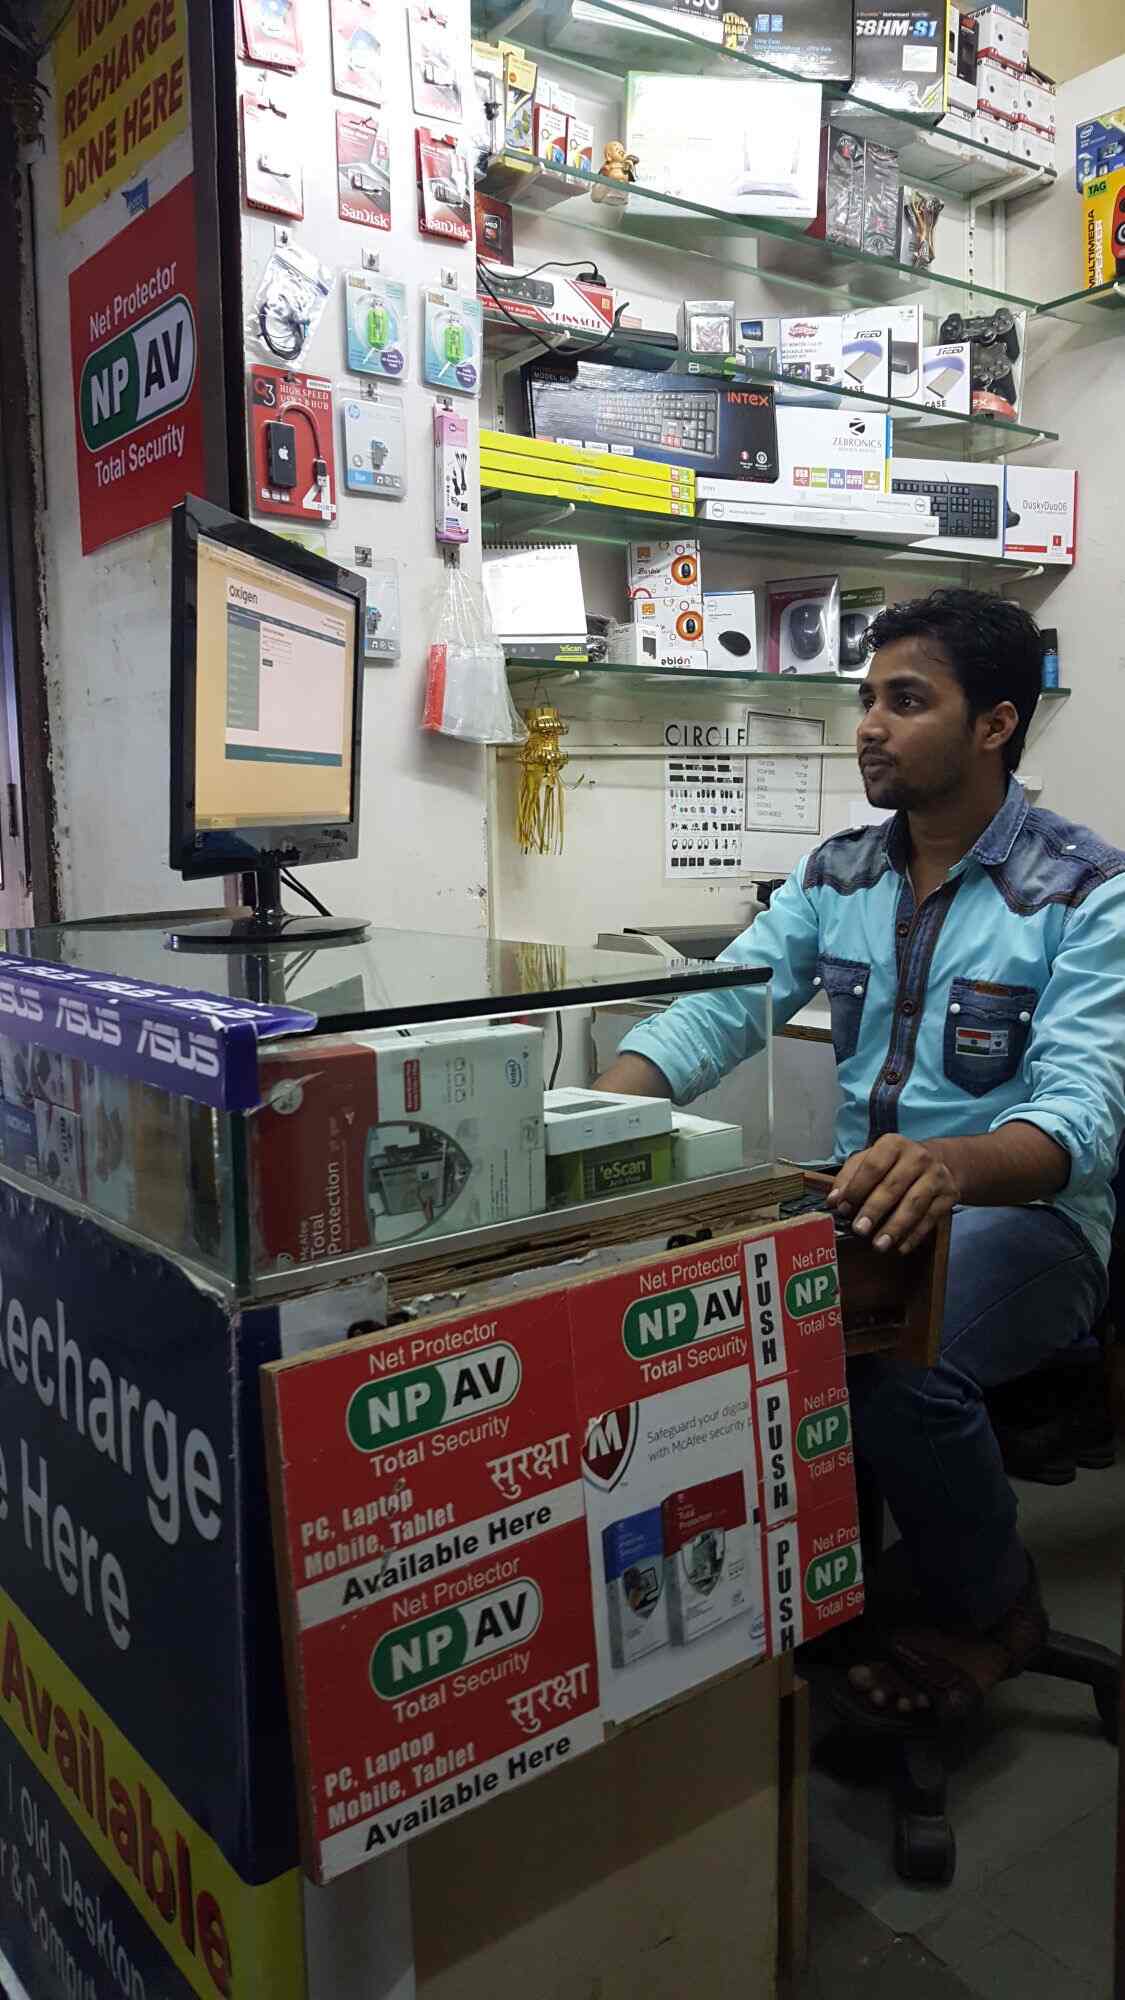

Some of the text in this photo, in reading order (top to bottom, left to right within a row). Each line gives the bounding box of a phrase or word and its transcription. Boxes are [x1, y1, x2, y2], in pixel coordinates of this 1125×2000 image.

[64, 0, 177, 139] RECHARGE
[65, 56, 184, 207] DONE HERE
[341, 203, 389, 228] SanDisk
[1087, 183, 1107, 197] TAG
[426, 217, 471, 241] SanDisk
[1087, 208, 1095, 289] MULTIMEDIA
[89, 262, 177, 342] Net Protector
[90, 320, 184, 426] NP AV
[302, 388, 329, 401] SPEED
[95, 424, 186, 487] Total Security
[832, 437, 882, 448] ZEBRONICS
[228, 584, 258, 605] oxigen
[0, 980, 43, 1022] SUS
[56, 997, 123, 1047] ASUS
[136, 1019, 220, 1078] ASUS
[602, 1158, 646, 1181] eScan
[309, 1212, 326, 1259] Total
[325, 1161, 341, 1255] Protection
[639, 1252, 739, 1293] Net Protector
[792, 1252, 813, 1271] Net
[795, 1276, 829, 1308] NP
[638, 1285, 743, 1345] NP AV
[754, 1252, 777, 1366] PUSH
[797, 1317, 825, 1338] Total
[369, 1320, 498, 1375] Net Protector
[640, 1335, 748, 1384] Total Security
[0, 1298, 222, 1545] echarge
[367, 1357, 505, 1435] NP AV
[647, 1416, 696, 1444] Safeguard
[697, 1409, 720, 1429] your
[803, 1393, 825, 1412] Net
[370, 1416, 511, 1478] Total Security
[672, 1434, 707, 1454] McAfee
[709, 1419, 745, 1441] security
[766, 1395, 789, 1510] PUSH
[806, 1416, 839, 1449] NP
[486, 1432, 571, 1500] सुरक्षा
[808, 1458, 836, 1480] Total
[20, 1437, 131, 1651] Here
[301, 1487, 414, 1548] PC, Laptop
[304, 1502, 455, 1580] Mobile, Tablet
[813, 1535, 835, 1553] Net
[342, 1505, 552, 1606] Available Here
[814, 1557, 848, 1591] NP
[392, 1557, 520, 1622] Net Protector
[776, 1538, 795, 1651] PUSH
[815, 1601, 844, 1621] Total
[390, 1592, 528, 1682] NP AV
[392, 1651, 531, 1724] Total Security
[506, 1663, 591, 1734] सुरक्षा
[324, 1731, 435, 1797] PC, Laptop
[328, 1742, 476, 1829] Mobile, Tablet
[364, 1736, 571, 1852] Available Here
[1, 1619, 233, 2000] Available
[20, 1785, 52, 1876] Old
